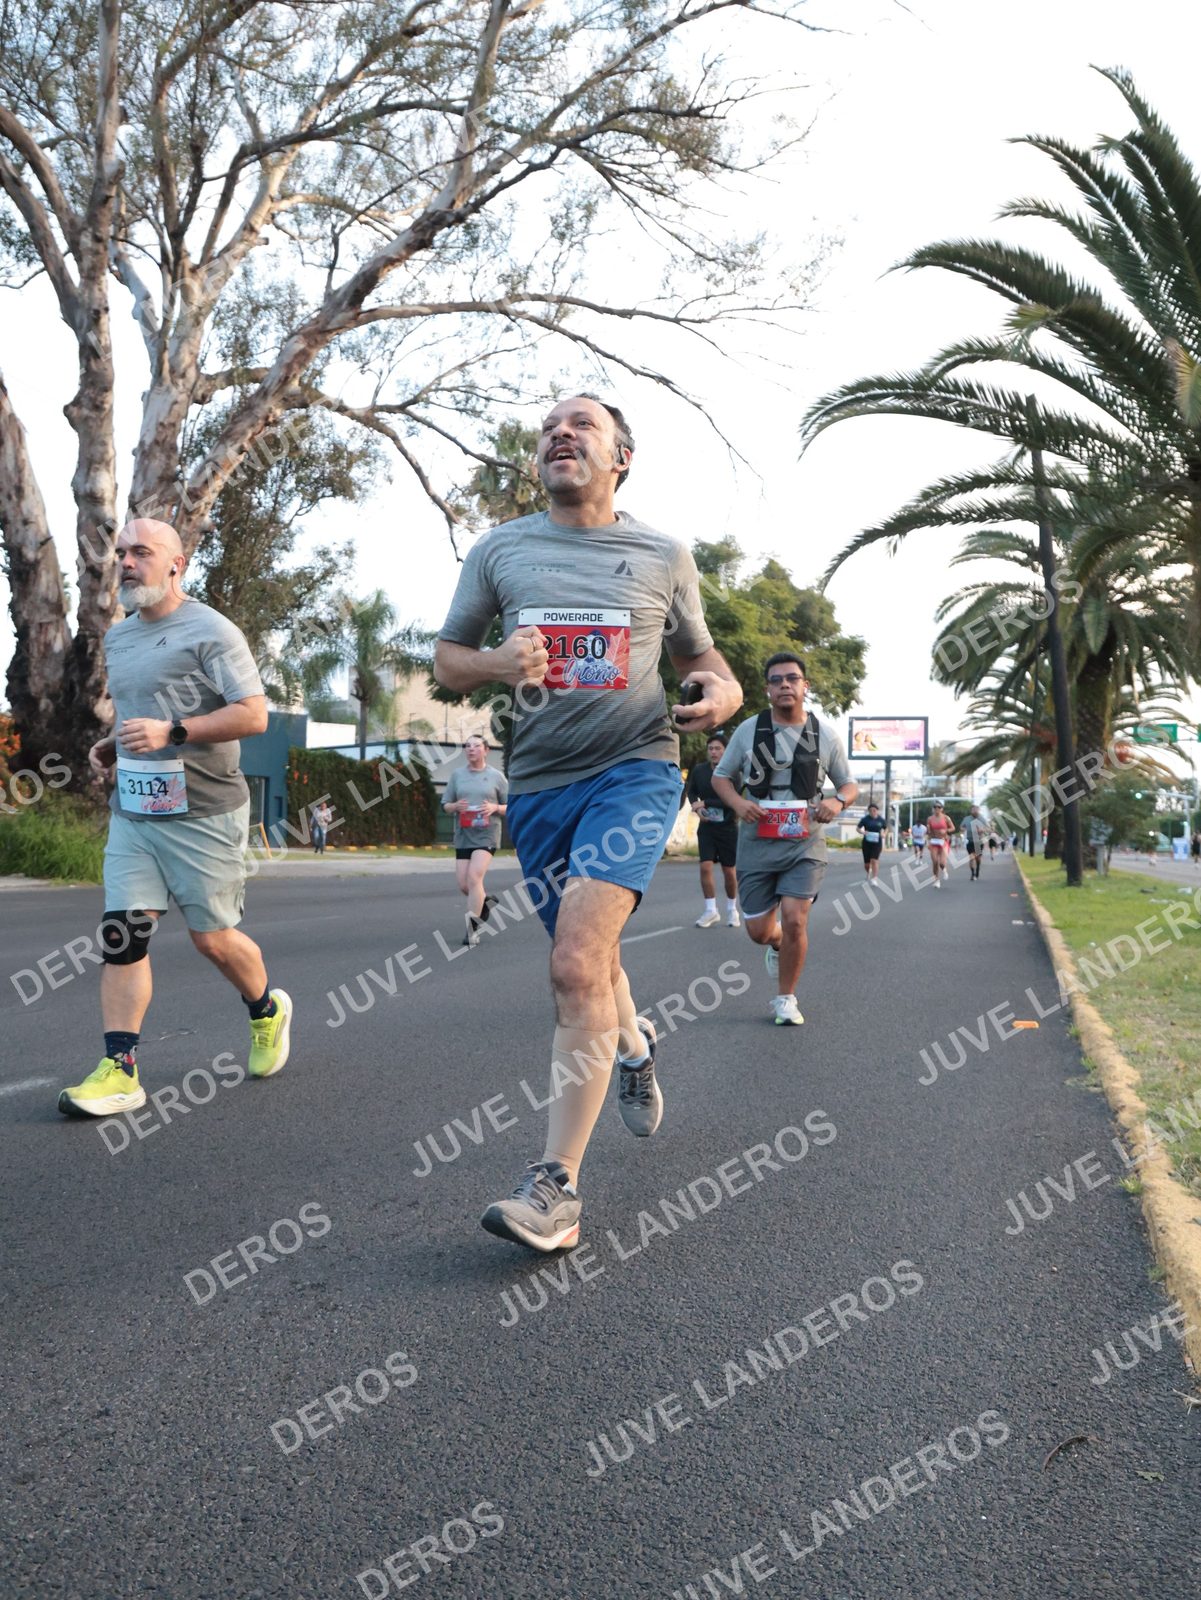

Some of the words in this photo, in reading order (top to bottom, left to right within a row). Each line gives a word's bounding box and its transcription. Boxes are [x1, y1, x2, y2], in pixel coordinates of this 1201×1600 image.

[543, 612, 604, 622] POWERADE
[127, 778, 169, 796] 3114
[767, 812, 799, 824] 2176
